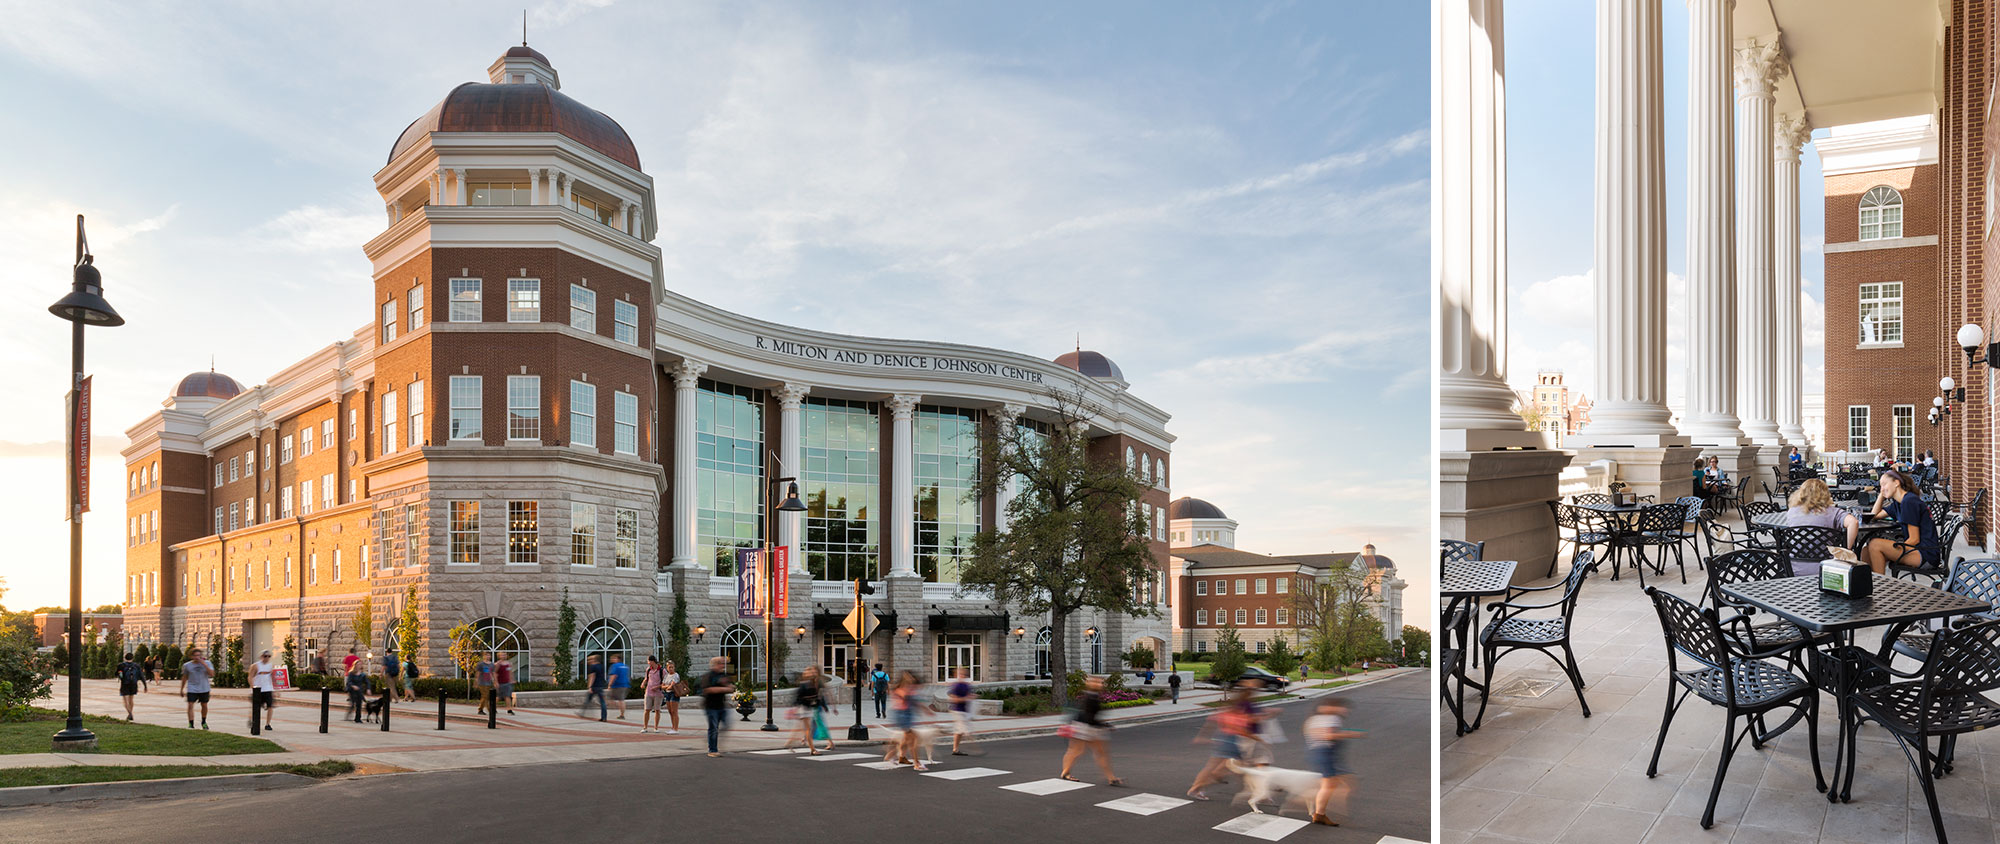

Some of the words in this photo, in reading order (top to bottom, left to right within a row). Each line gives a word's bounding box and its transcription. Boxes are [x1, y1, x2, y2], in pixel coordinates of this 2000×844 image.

[756, 336, 767, 349] R.
[773, 340, 828, 359] MILTON
[834, 351, 868, 364] AND
[873, 353, 927, 368] DENICE
[933, 358, 997, 375] JOHNSON
[1001, 366, 1043, 384] CENTER
[81, 468, 88, 477] IN
[746, 552, 758, 561] 125
